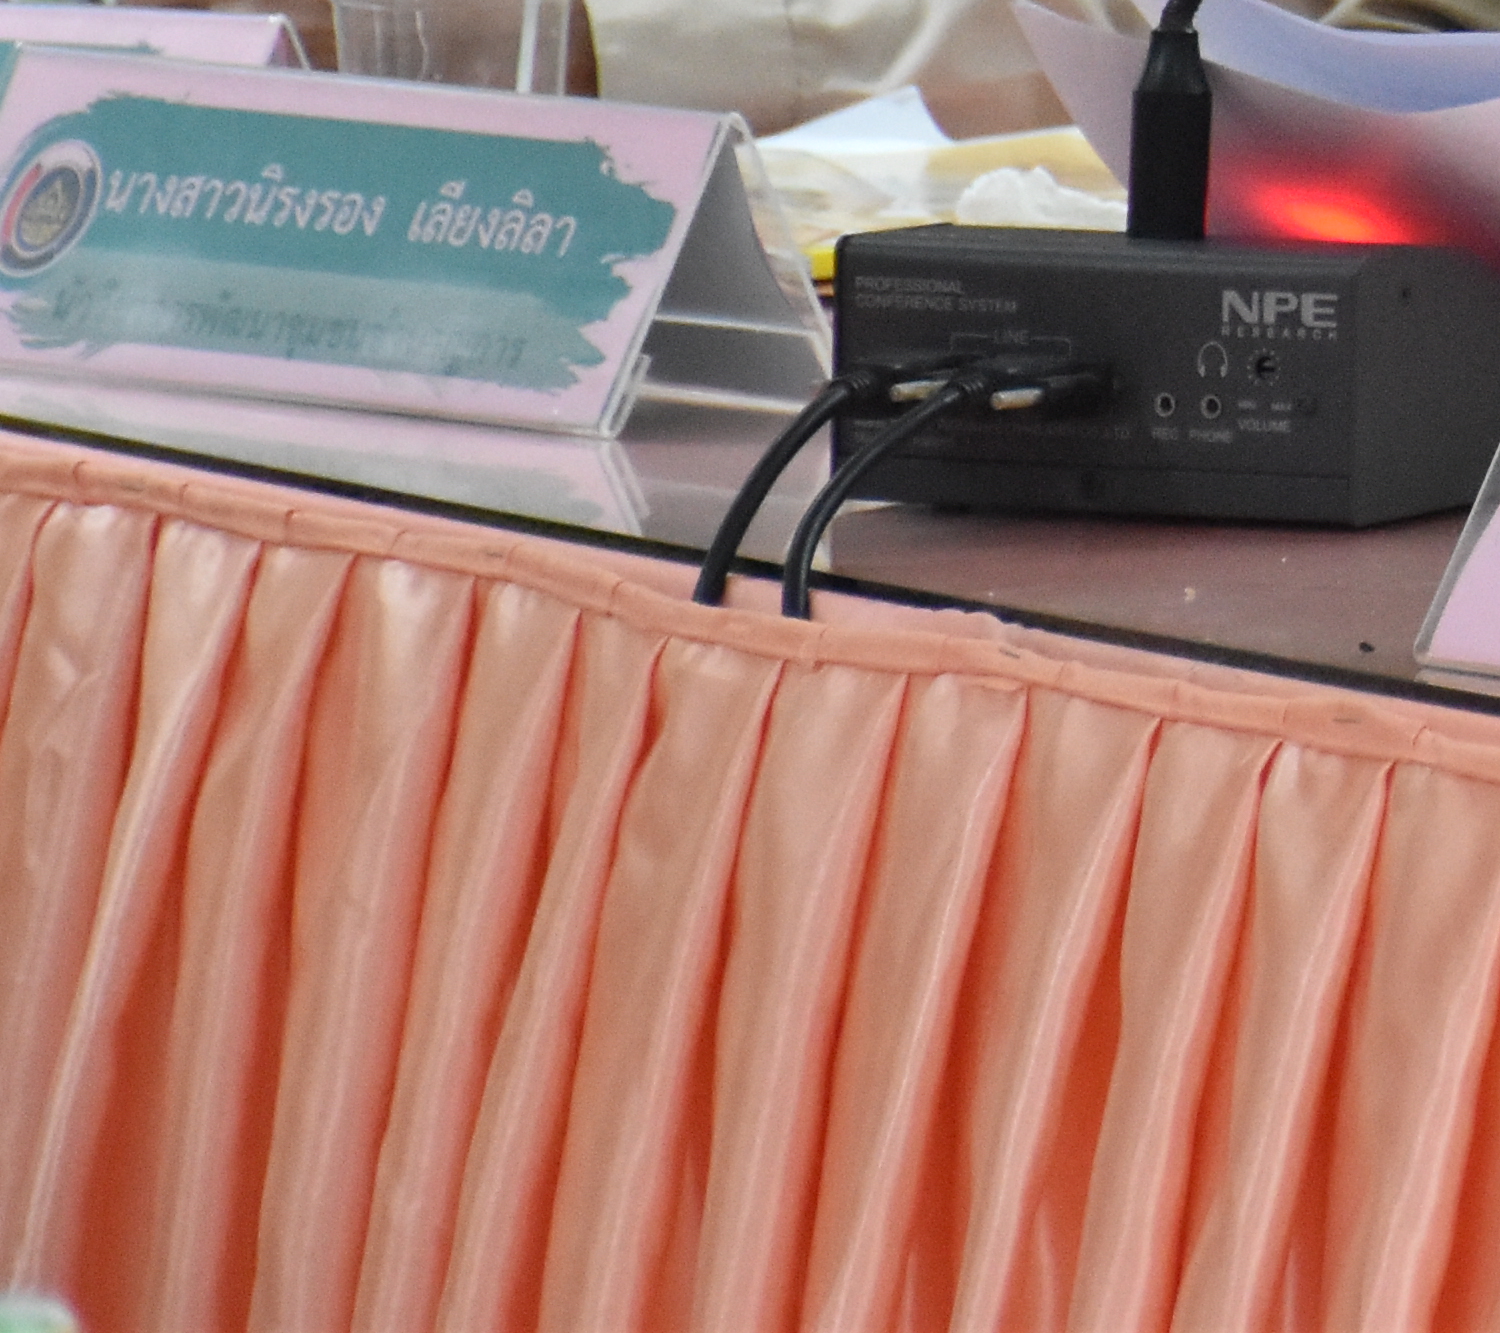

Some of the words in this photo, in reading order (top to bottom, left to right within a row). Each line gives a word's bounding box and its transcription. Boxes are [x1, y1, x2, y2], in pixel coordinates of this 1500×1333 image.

[105, 162, 386, 237] นางสาวนิรงรอง
[1221, 290, 1338, 329] NPE
